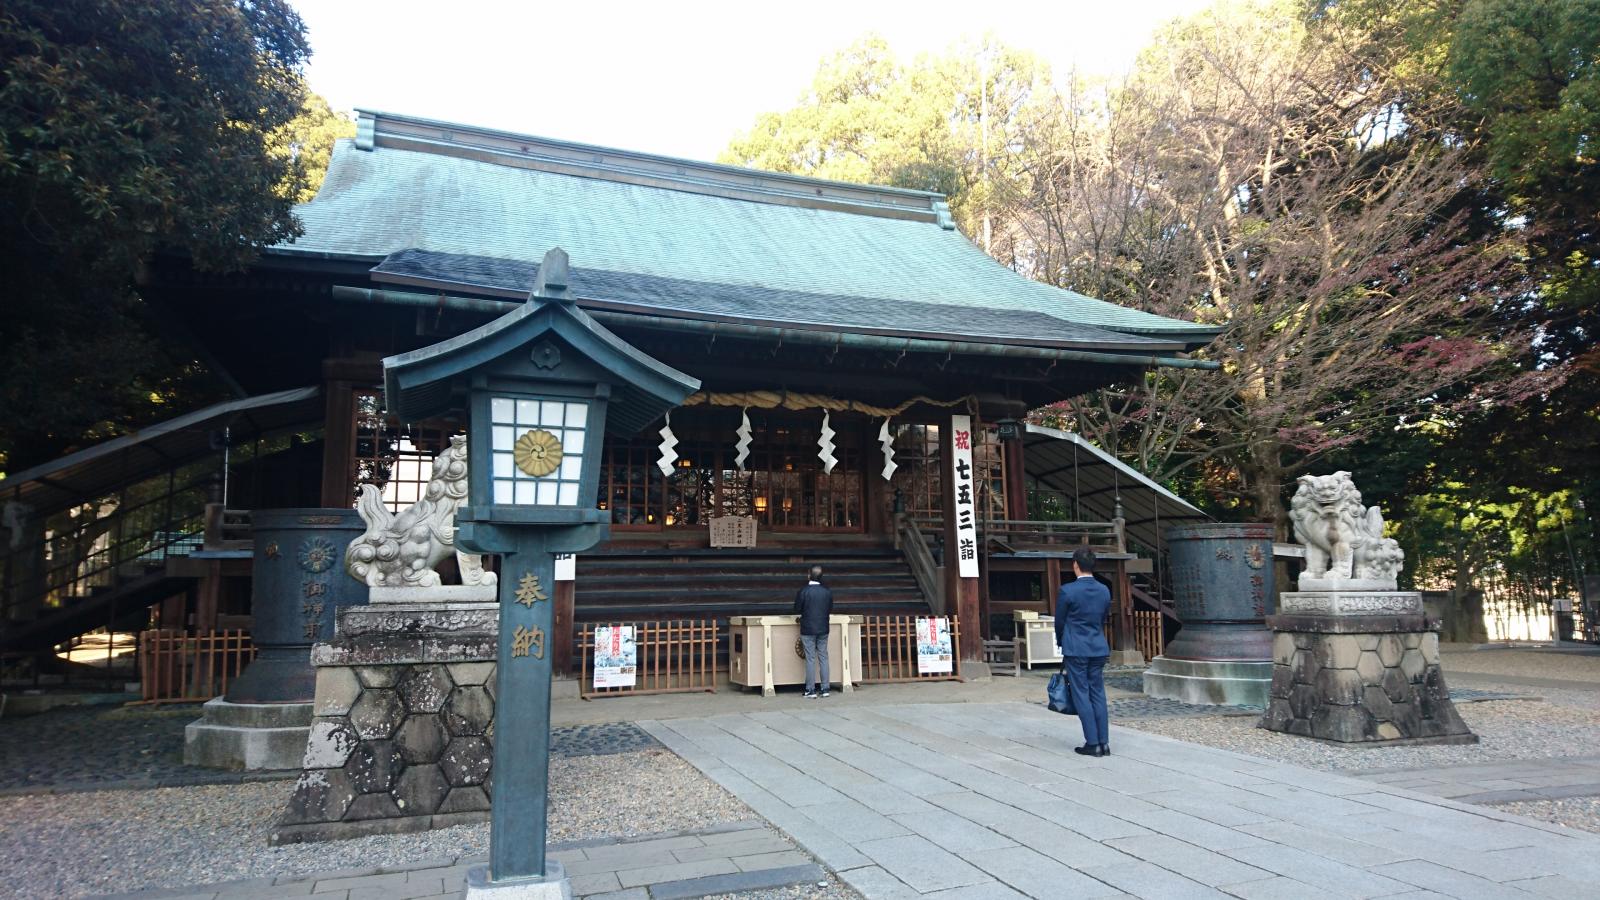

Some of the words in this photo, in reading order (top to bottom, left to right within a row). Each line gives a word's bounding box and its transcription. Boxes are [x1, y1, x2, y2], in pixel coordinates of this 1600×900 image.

[955, 429, 975, 560] 祝七五三詣
[511, 571, 548, 660] 奉納
